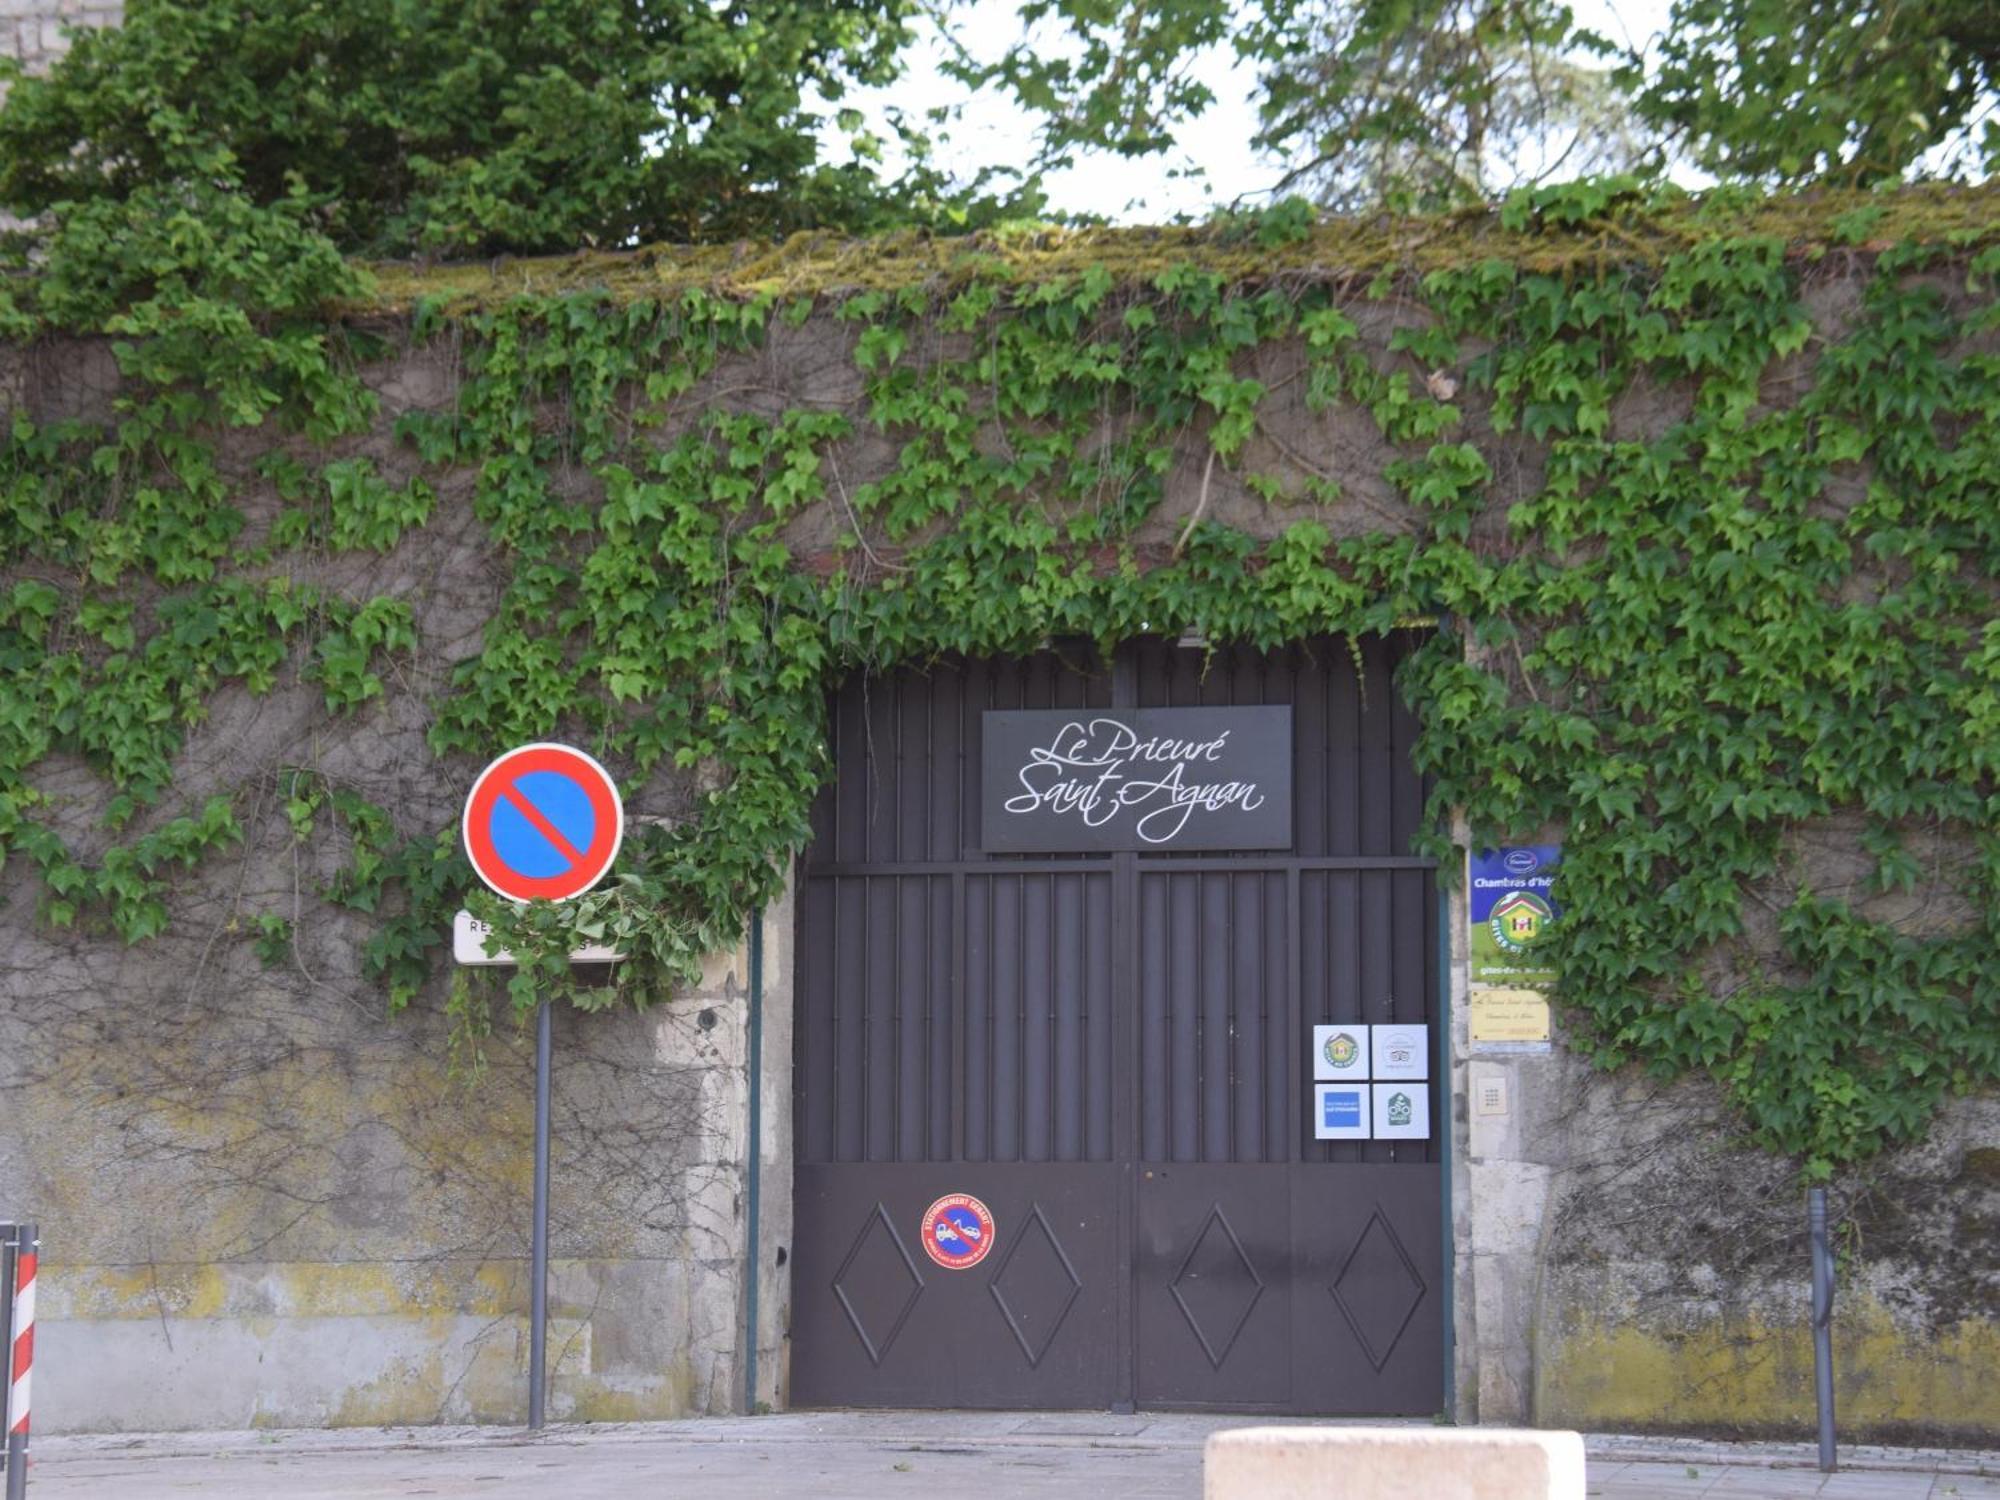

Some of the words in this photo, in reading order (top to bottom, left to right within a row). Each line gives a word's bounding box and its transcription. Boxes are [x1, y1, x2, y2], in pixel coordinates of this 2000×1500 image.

[1030, 722, 1115, 765] Le
[1089, 718, 1231, 763] Prieuré
[1474, 877, 1526, 888] Chambres
